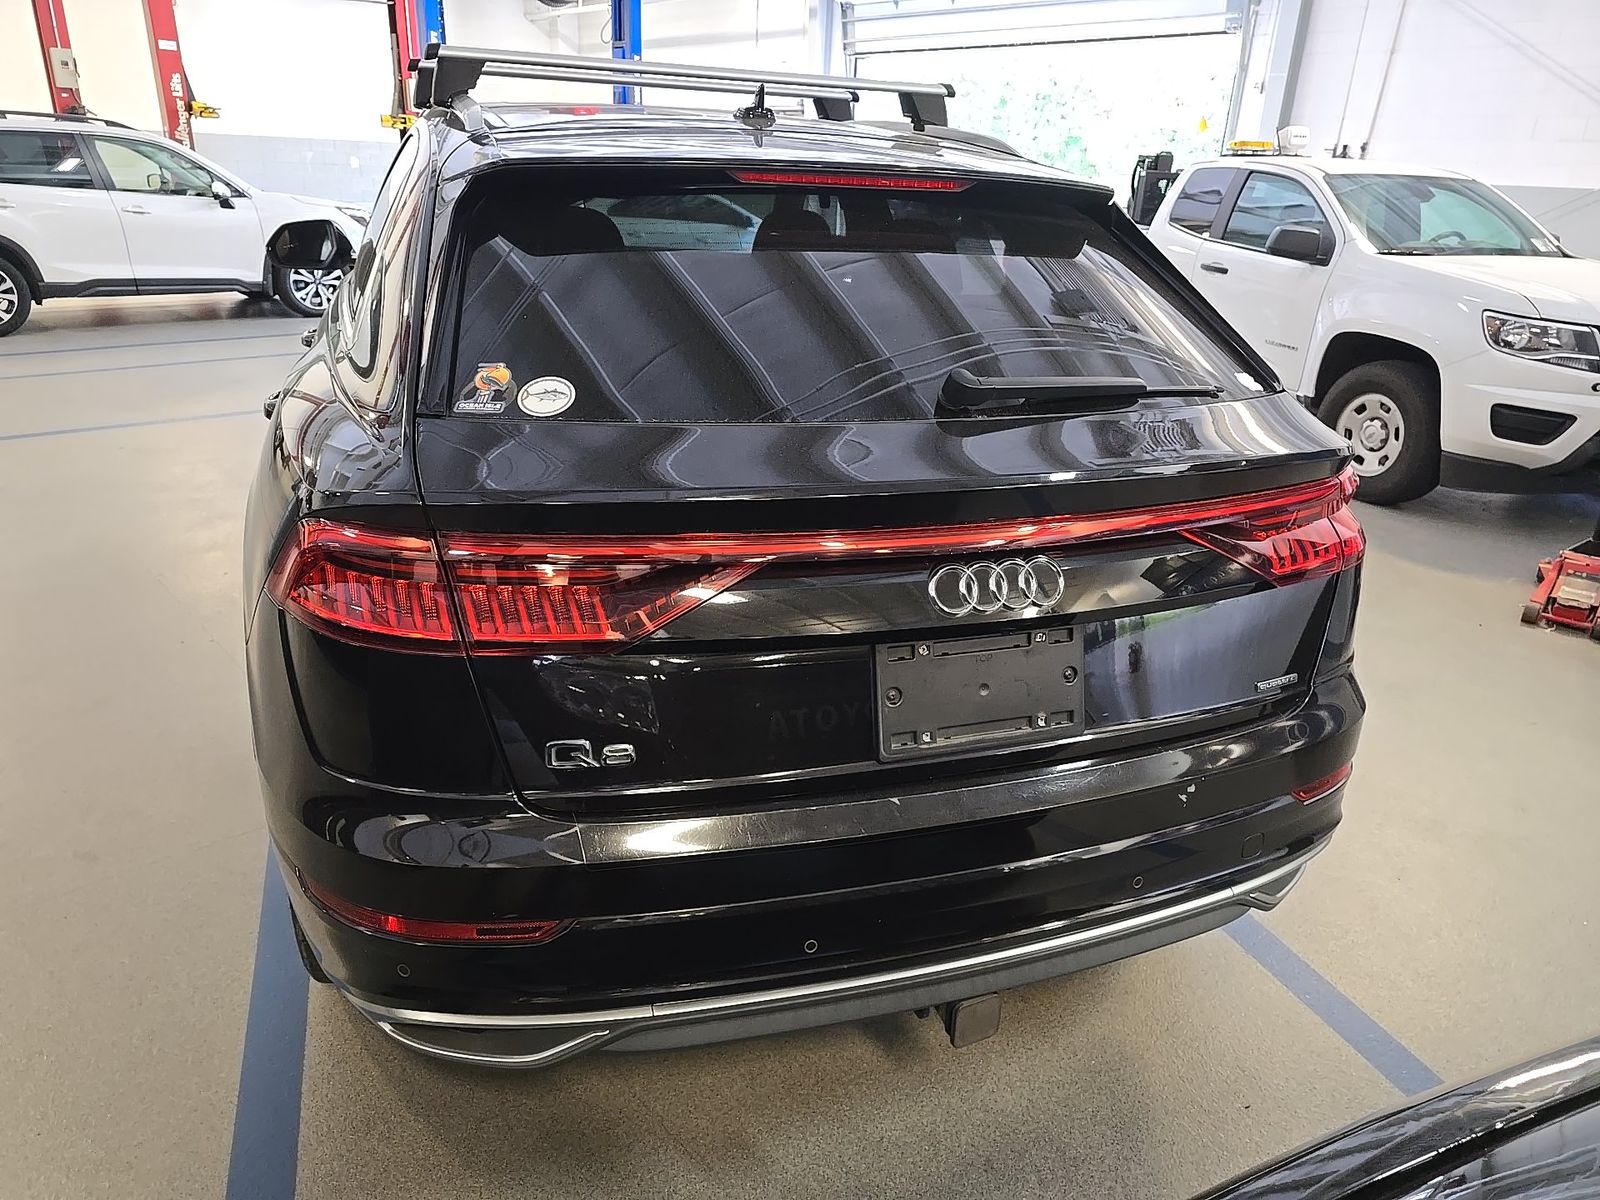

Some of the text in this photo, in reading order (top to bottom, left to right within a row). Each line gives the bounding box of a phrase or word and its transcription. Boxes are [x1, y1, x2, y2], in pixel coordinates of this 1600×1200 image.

[169, 72, 190, 149] allenger Lifts
[544, 739, 636, 769] Q8
